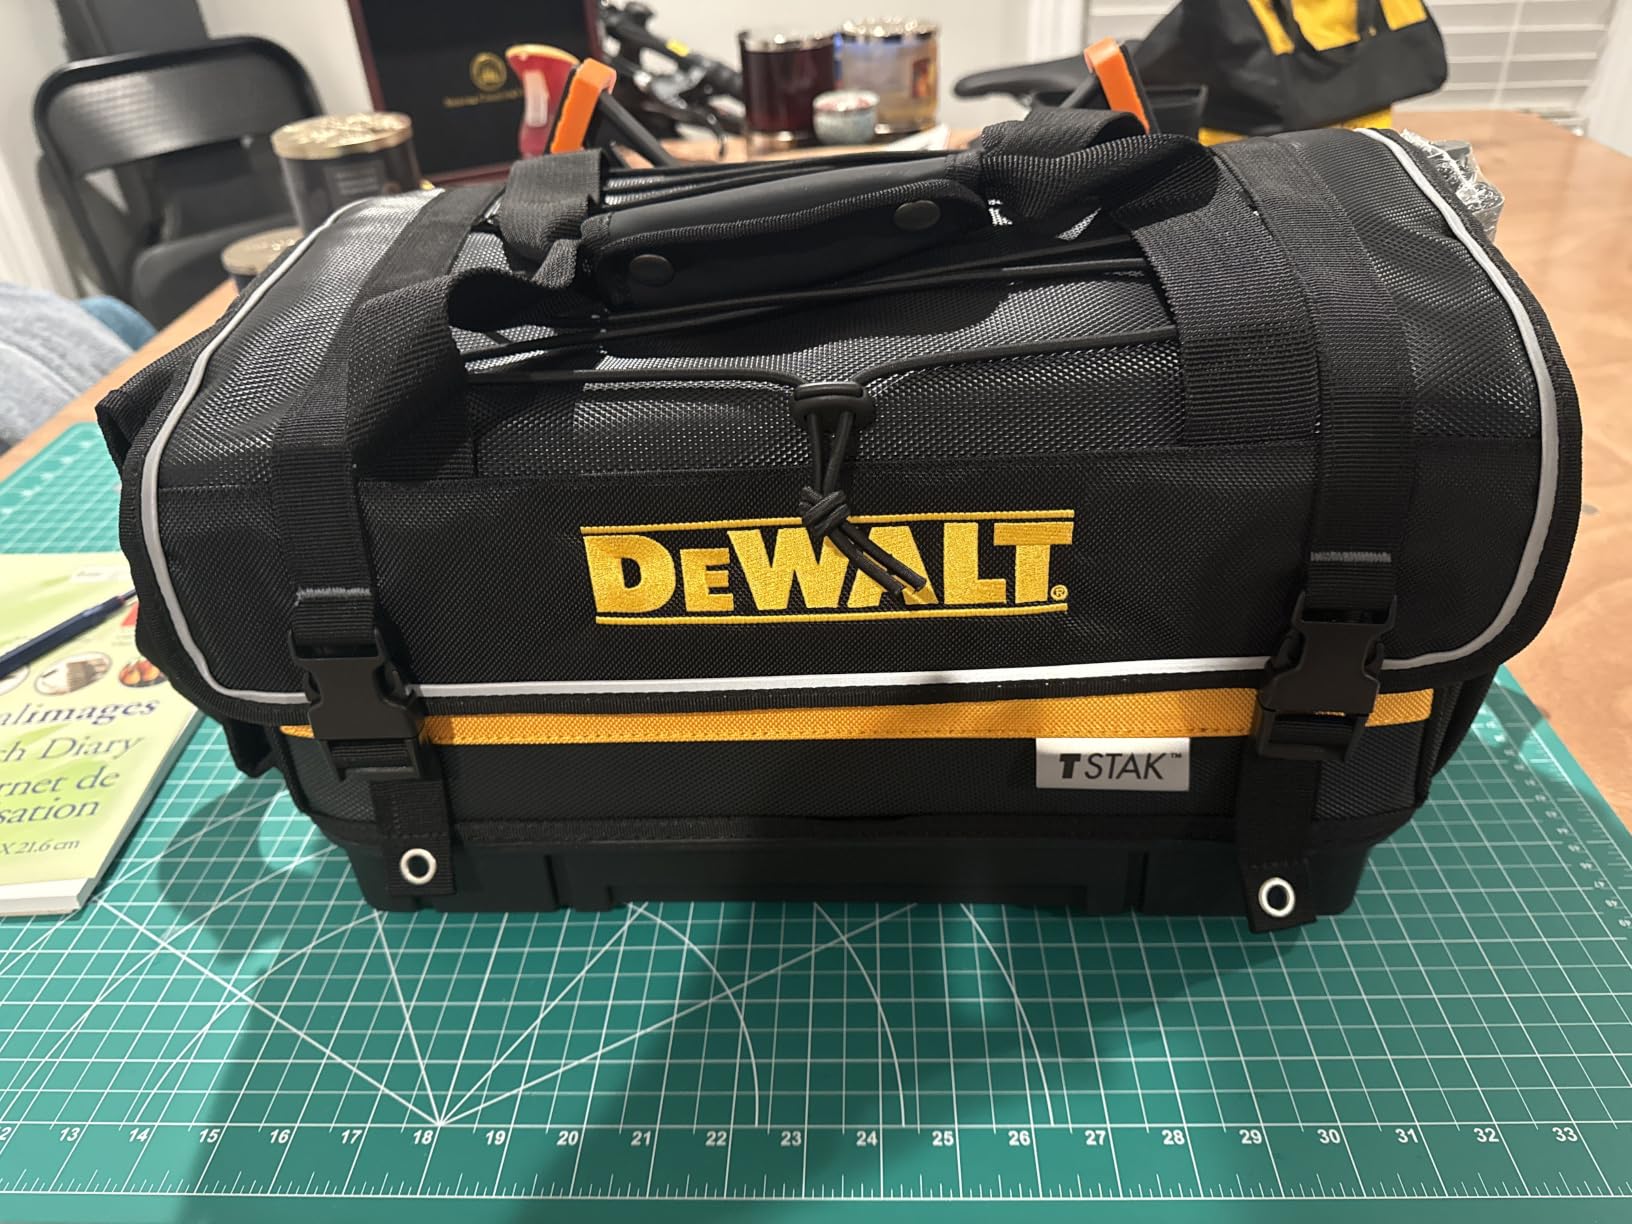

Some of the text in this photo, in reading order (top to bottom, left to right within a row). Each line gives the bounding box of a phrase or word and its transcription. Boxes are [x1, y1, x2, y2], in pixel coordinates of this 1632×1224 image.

[0, 736, 145, 762] h Diary
[76, 766, 120, 790] de
[15, 837, 55, 854] 21.6
[53, 840, 80, 850] cm
[0, 1126, 1578, 1147] 2 13 14 15 16 17 18 19 20 21 22 23 24 25 26 27 28 29 30 31 32 33
